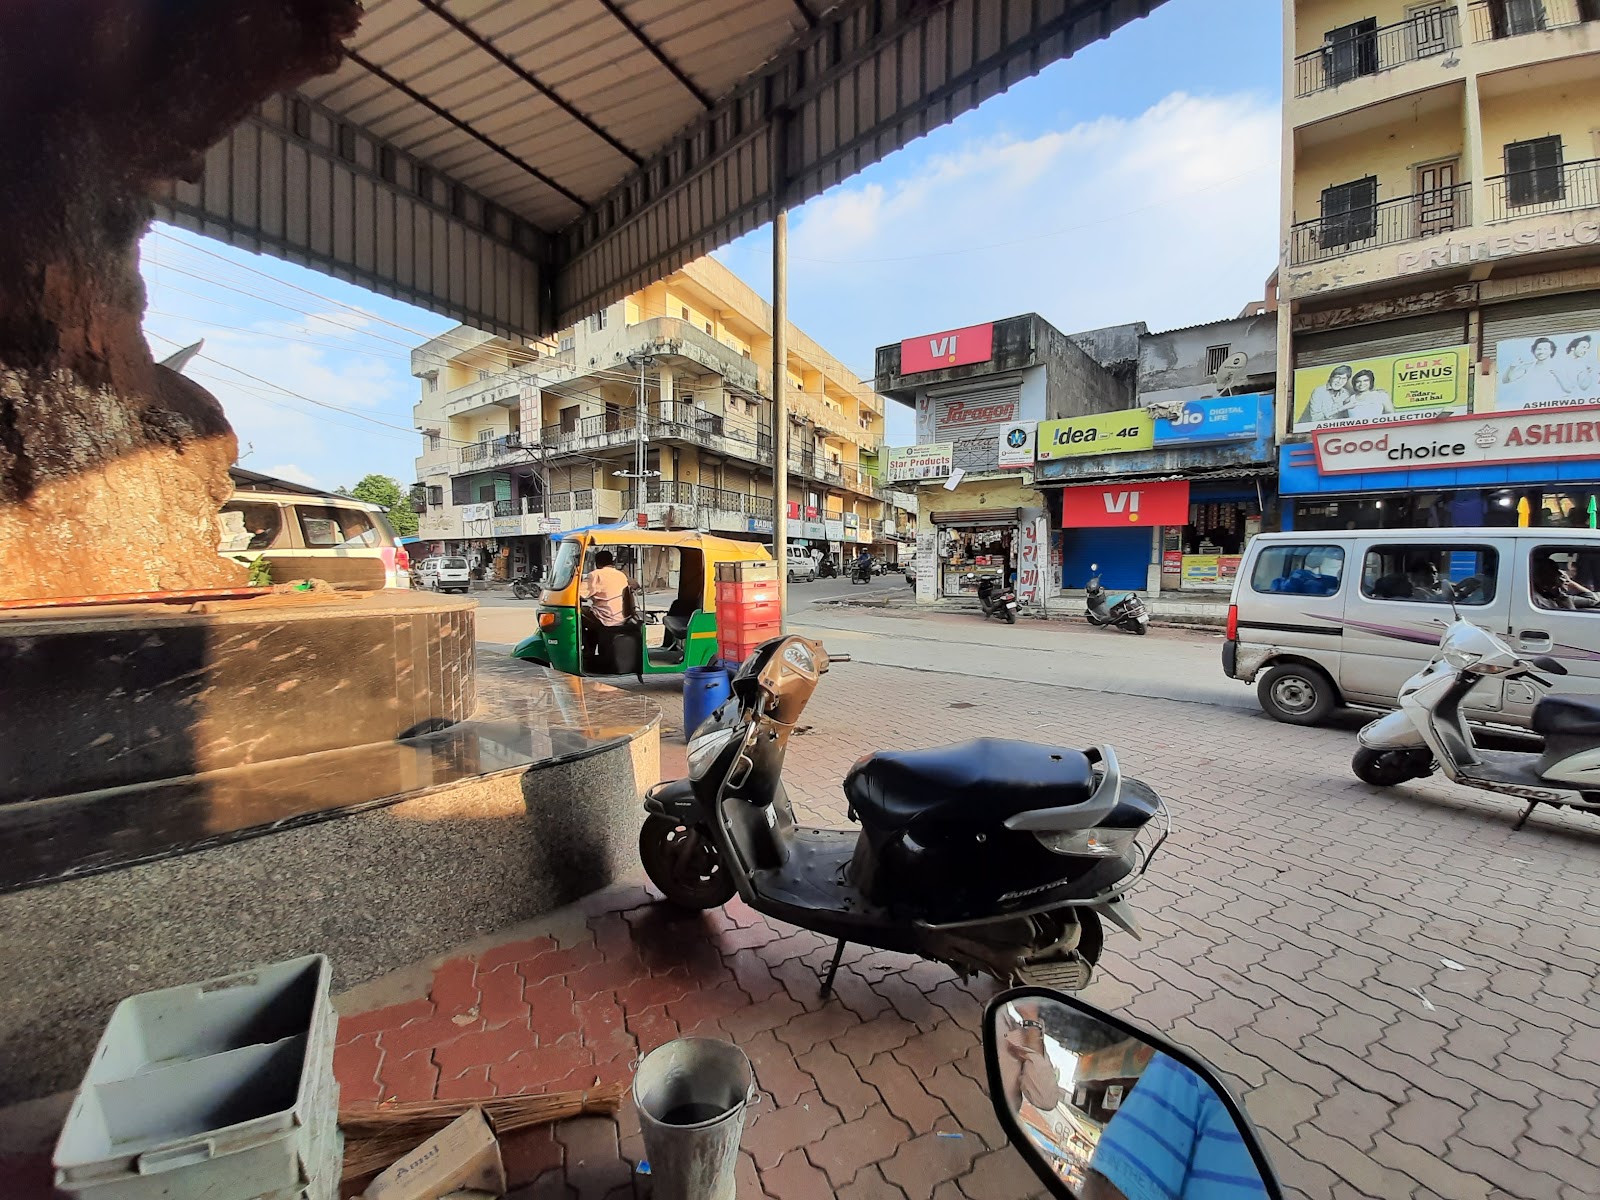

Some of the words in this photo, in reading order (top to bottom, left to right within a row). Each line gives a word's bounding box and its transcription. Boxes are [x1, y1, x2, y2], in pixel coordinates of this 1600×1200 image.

[1405, 359, 1442, 369] LUX
[1397, 366, 1453, 381] VENUS
[1522, 399, 1585, 409] ASHIRWAD
[1209, 407, 1243, 415] DIGITAL
[1171, 409, 1203, 426] Jio
[1209, 414, 1229, 422] LIFE
[1316, 419, 1368, 429] ASHIRWAD
[1116, 426, 1139, 438] 4G
[1324, 434, 1389, 456] Good
[1388, 441, 1466, 460] choice
[889, 460, 908, 468] Star
[910, 456, 950, 467] Products
[395, 1144, 440, 1177] Amul
